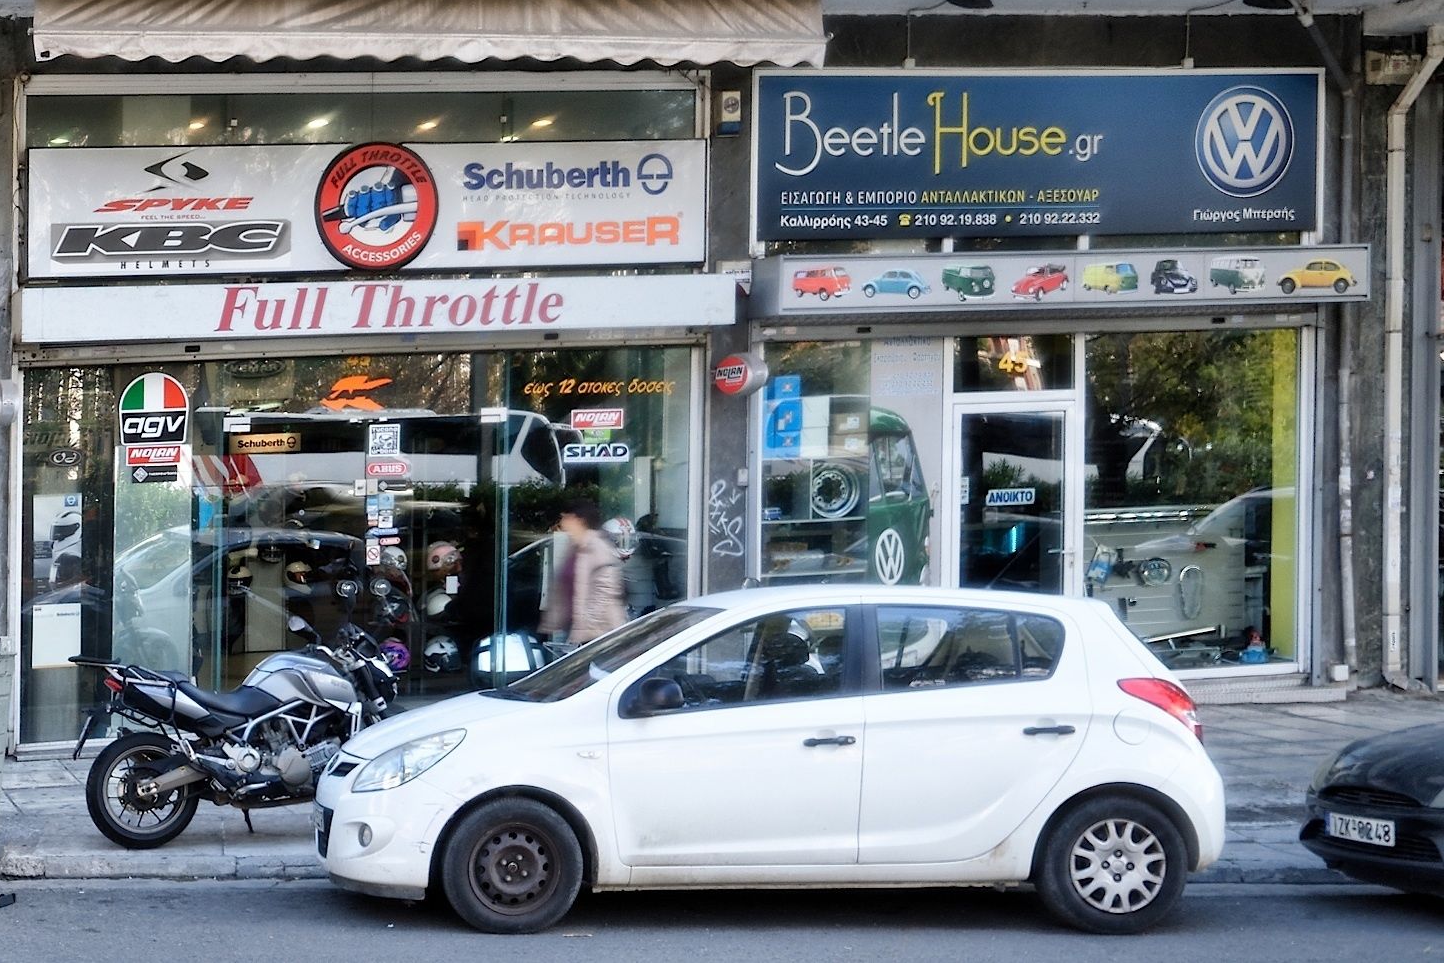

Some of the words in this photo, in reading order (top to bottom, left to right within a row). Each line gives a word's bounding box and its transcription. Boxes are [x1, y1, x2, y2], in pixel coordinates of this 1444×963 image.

[330, 158, 358, 189] FULL
[361, 149, 427, 184] THROTTLE
[462, 160, 631, 190] Schuberth
[93, 196, 254, 213] SPYKE
[462, 194, 490, 203] HEAD
[565, 191, 632, 200] TECHNOLOGY
[780, 191, 841, 206] ΕΙΣΑΓΩΓΗ
[845, 191, 854, 205] &
[858, 190, 917, 205] ΕΜΠΟΡΙΟ
[920, 189, 1026, 204] ΑΝΤΑΛΛΑΚΤΙΚΩΝ
[1037, 188, 1100, 203] ΑΞΕΣΟΥΑΡ
[780, 214, 852, 229] Καλλιρρόης
[854, 214, 888, 226] 43-45
[914, 214, 937, 226] 210
[939, 213, 997, 226] 92.19.838
[1019, 212, 1041, 225] 210
[1043, 212, 1101, 225] 92.22.332
[1193, 208, 1241, 223] Γιώργος
[1243, 206, 1296, 221] Μπερσής
[52, 220, 284, 257] KBC
[461, 216, 680, 251] KRAUSER
[342, 231, 423, 263] ACCESSORIES
[120, 258, 212, 270] HELMETS
[214, 286, 329, 332] Full
[351, 282, 564, 329] Throttle
[998, 352, 1029, 374] 45
[716, 365, 744, 379] NOLAN
[558, 378, 575, 394] 12
[123, 415, 185, 438] agv
[574, 411, 620, 425] NOLAN
[237, 438, 286, 449] Schuberth
[566, 445, 628, 458] SHAD
[130, 447, 179, 462] NOLAN
[373, 465, 402, 474] ABUS
[988, 490, 1033, 504] ΑΝΟΙΚΤΟ
